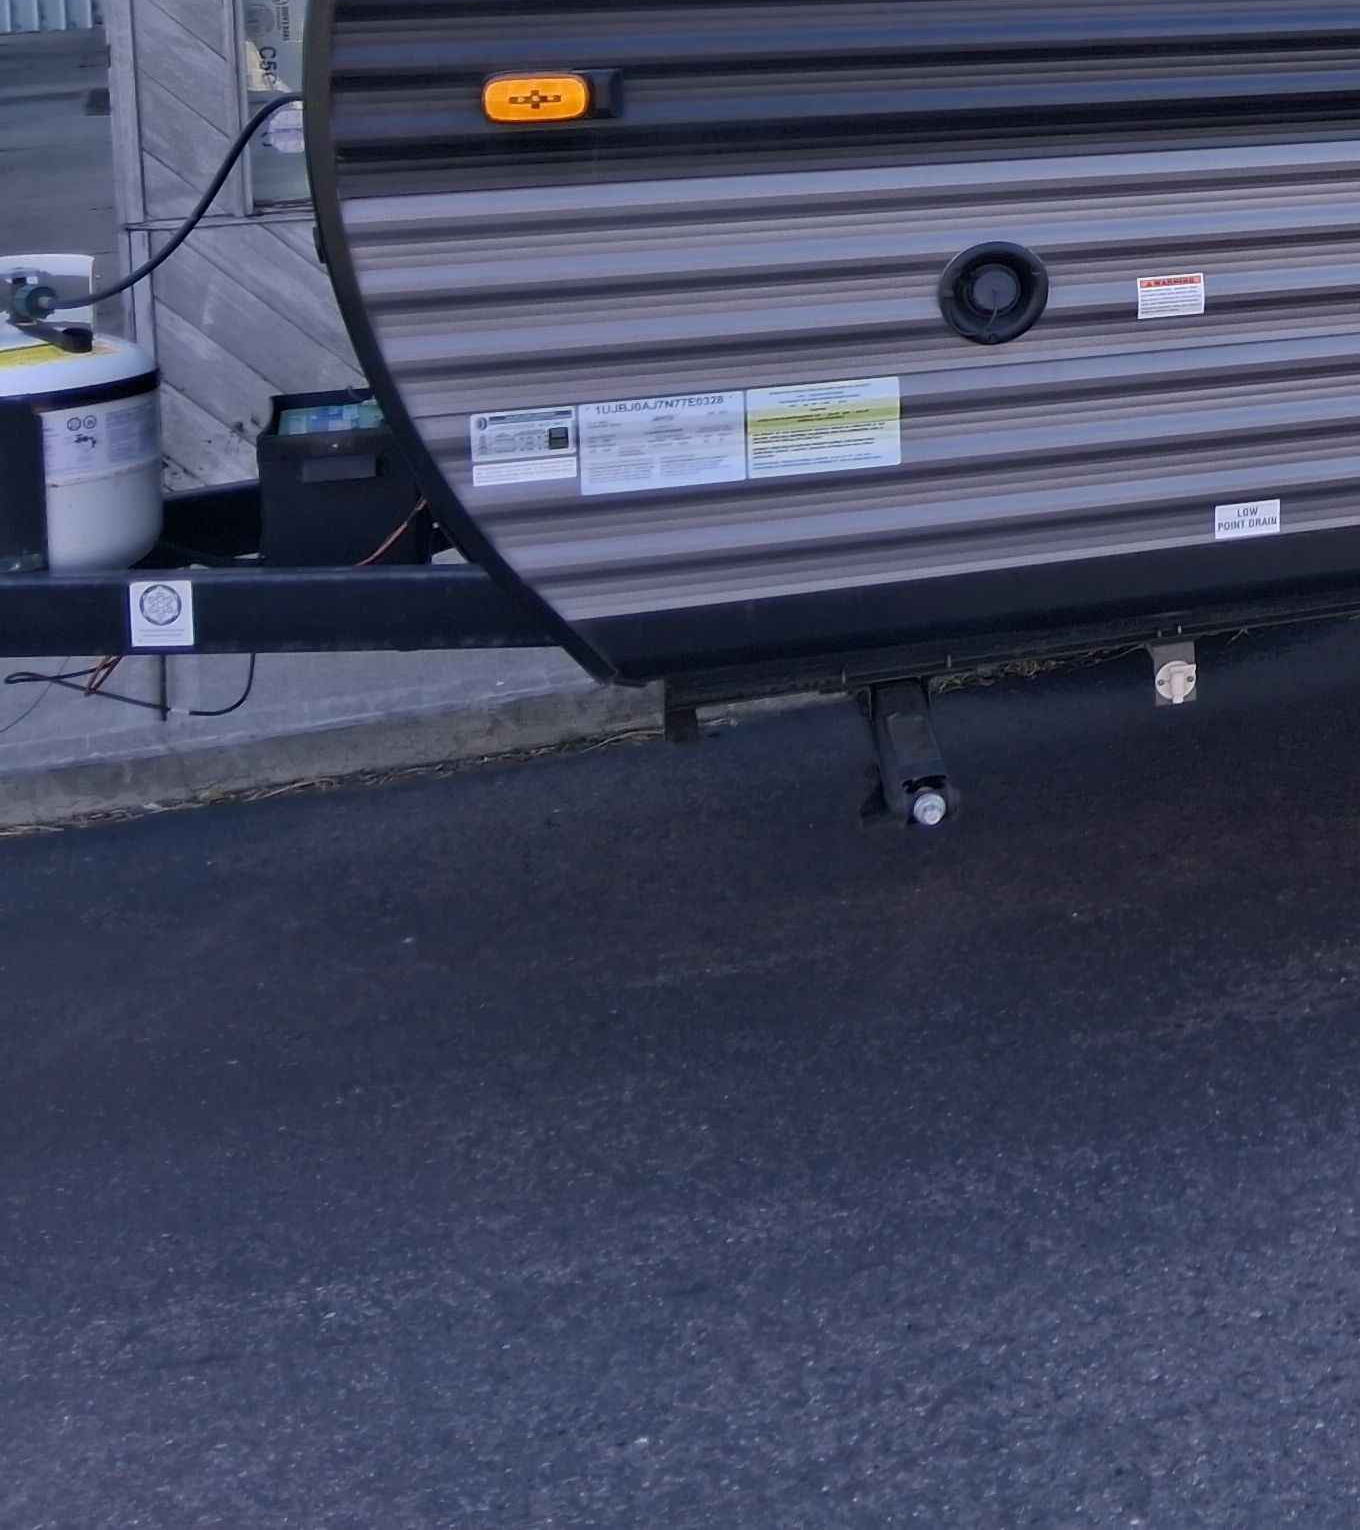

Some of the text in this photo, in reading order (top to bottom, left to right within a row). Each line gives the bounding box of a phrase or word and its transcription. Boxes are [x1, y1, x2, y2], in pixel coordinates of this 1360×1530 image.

[1237, 506, 1258, 518] LOW
[1218, 517, 1277, 531] POINT DRAIN
